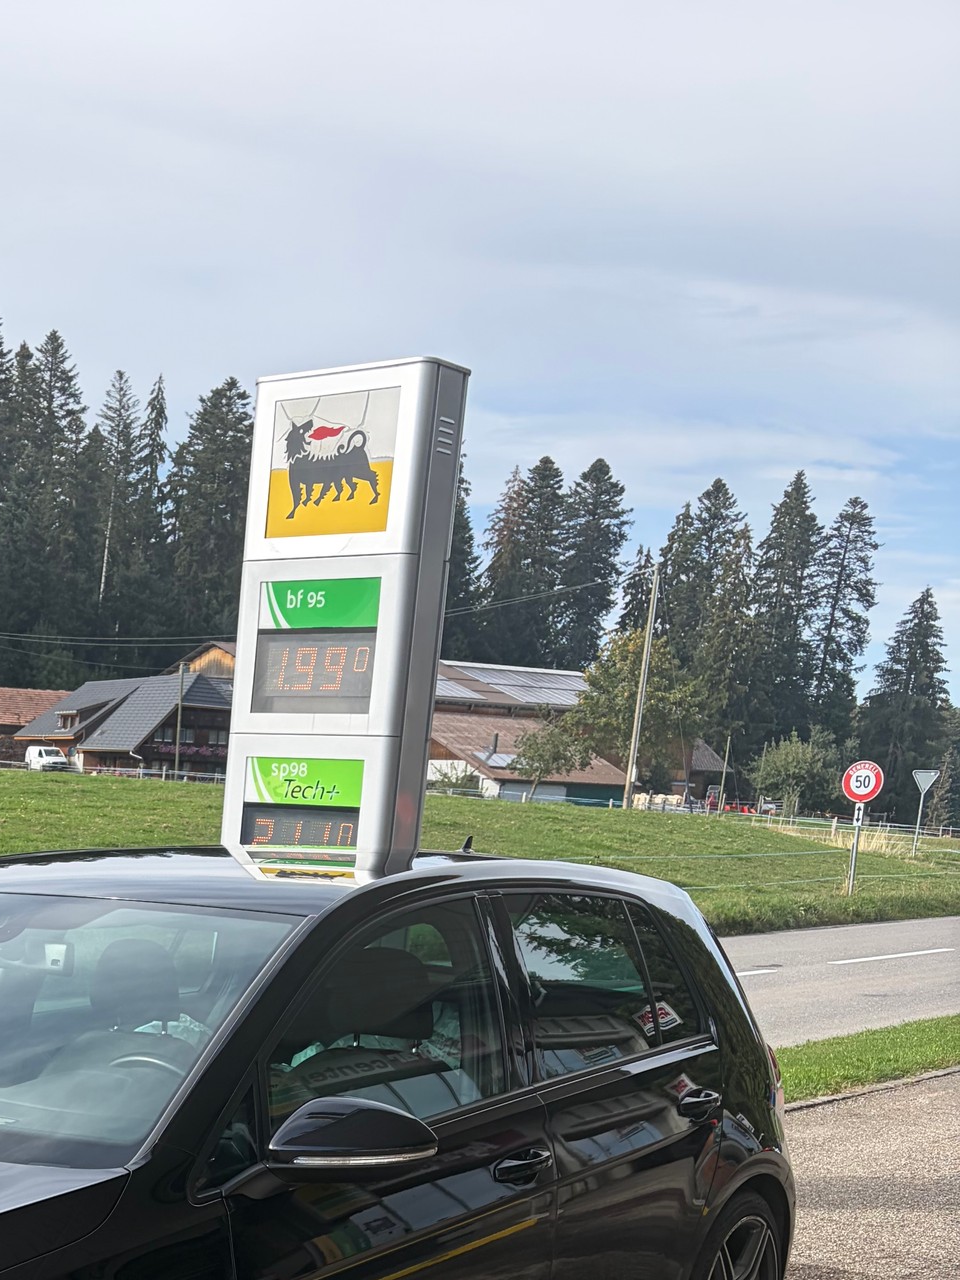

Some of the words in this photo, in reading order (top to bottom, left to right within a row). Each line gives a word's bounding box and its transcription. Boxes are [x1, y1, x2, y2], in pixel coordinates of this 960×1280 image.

[286, 589, 304, 608] bf
[307, 591, 326, 608] 95
[271, 762, 308, 781] sp98
[283, 778, 340, 800] Tech+
[855, 775, 871, 789] 50
